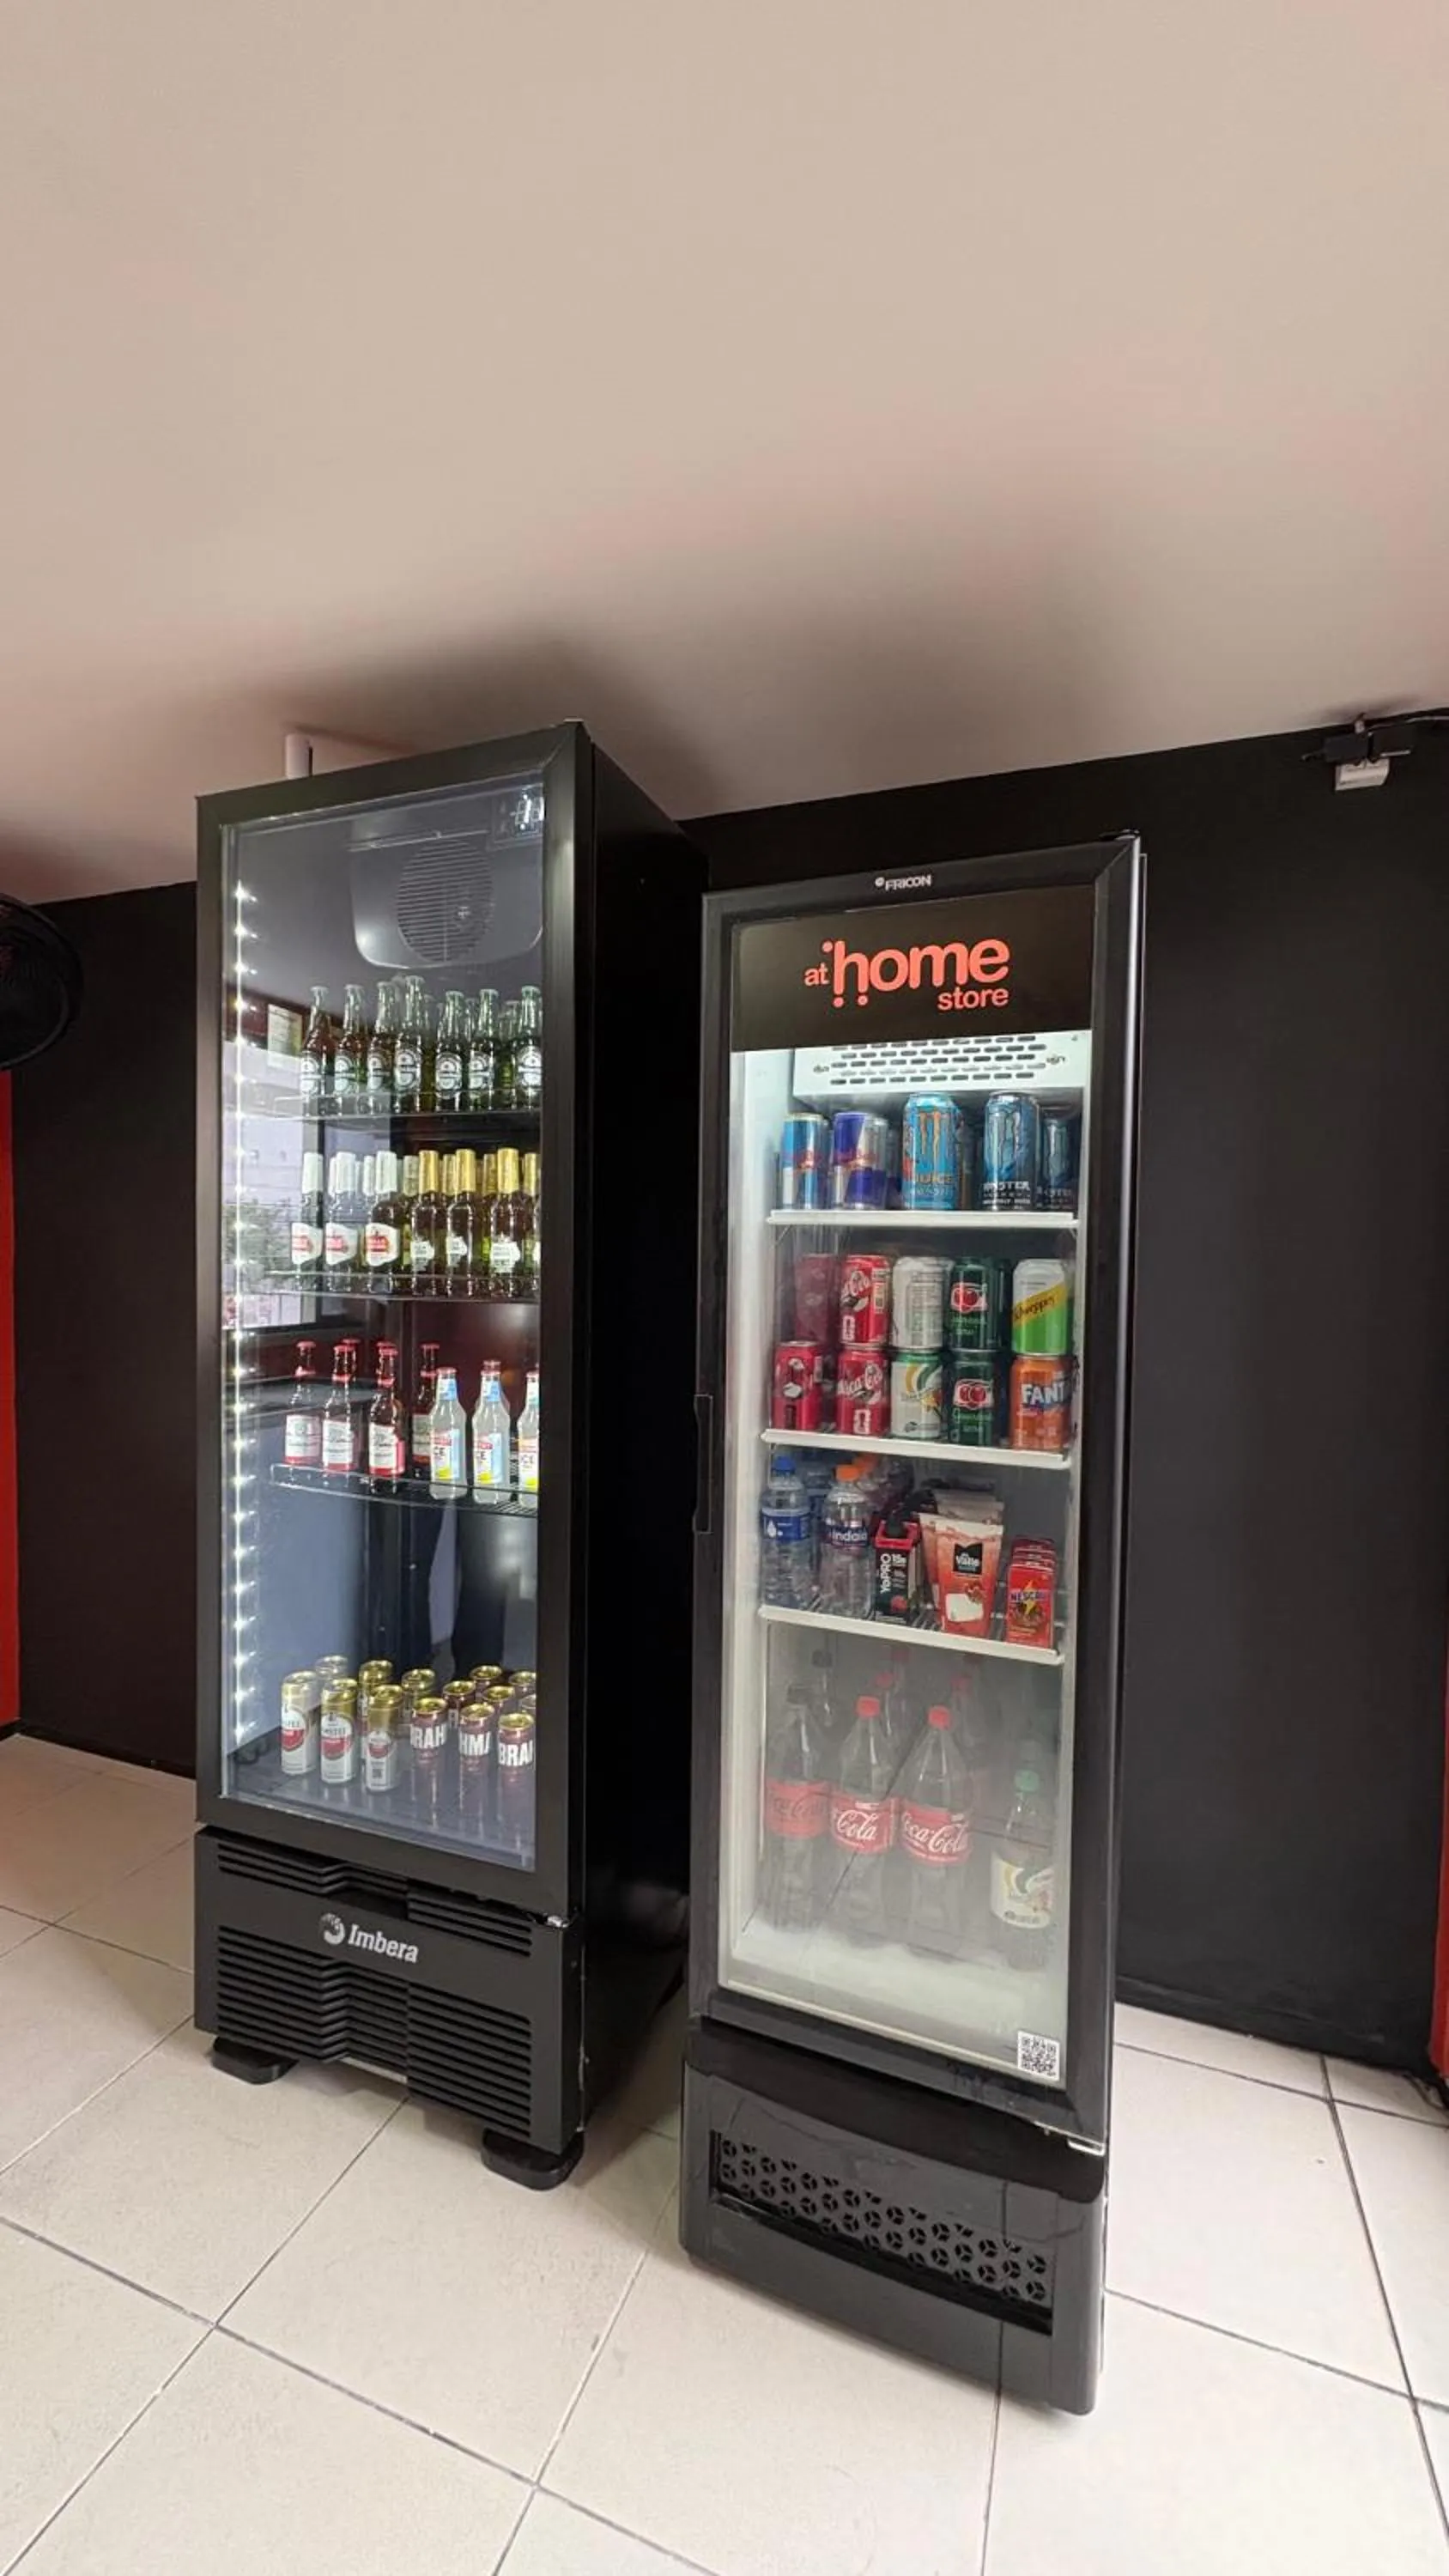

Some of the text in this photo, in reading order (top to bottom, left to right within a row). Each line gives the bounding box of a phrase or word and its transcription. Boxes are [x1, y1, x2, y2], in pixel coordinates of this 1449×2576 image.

[885, 874, 931, 890] FRICON
[804, 939, 1010, 993] at home
[937, 987, 1009, 1011] store
[348, 1923, 418, 1964] Imbera
